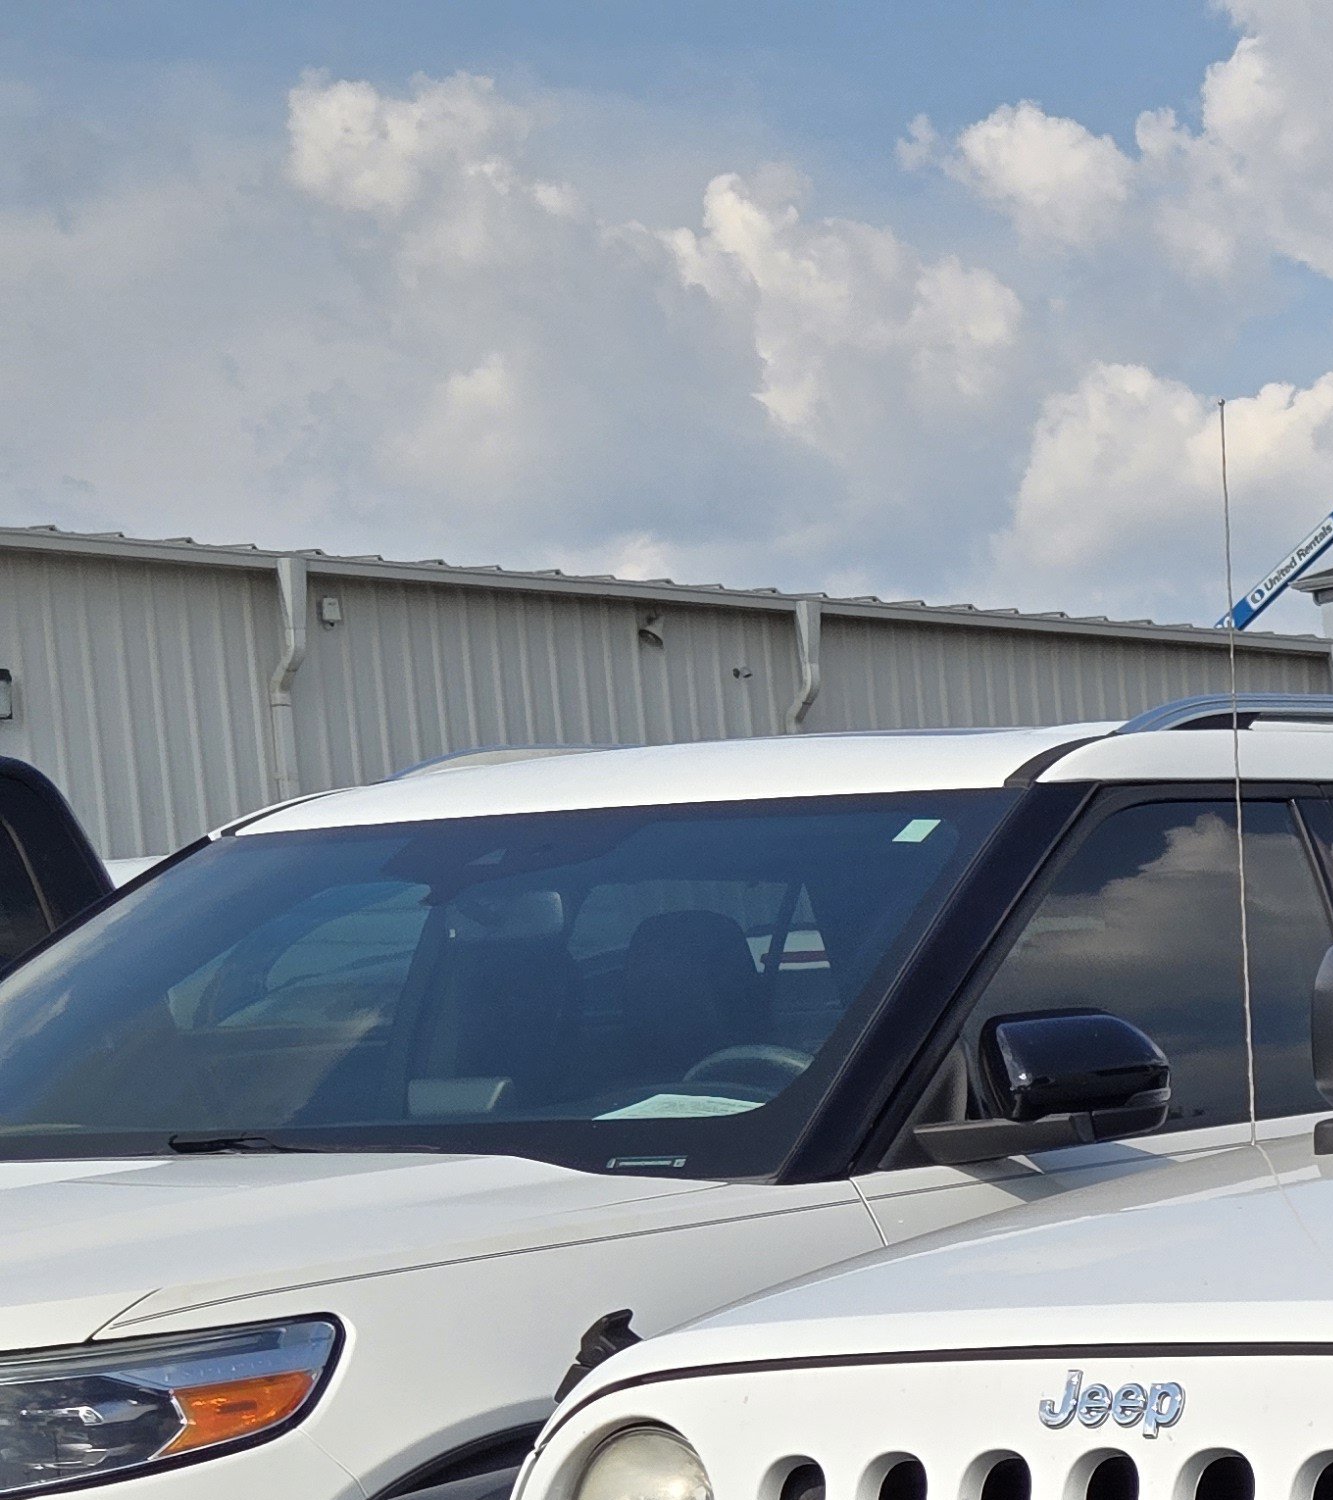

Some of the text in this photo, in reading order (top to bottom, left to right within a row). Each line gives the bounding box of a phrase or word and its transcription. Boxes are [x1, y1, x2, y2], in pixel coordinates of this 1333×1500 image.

[1263, 524, 1333, 591] United Rentals
[1038, 1369, 1186, 1440] Jeep
